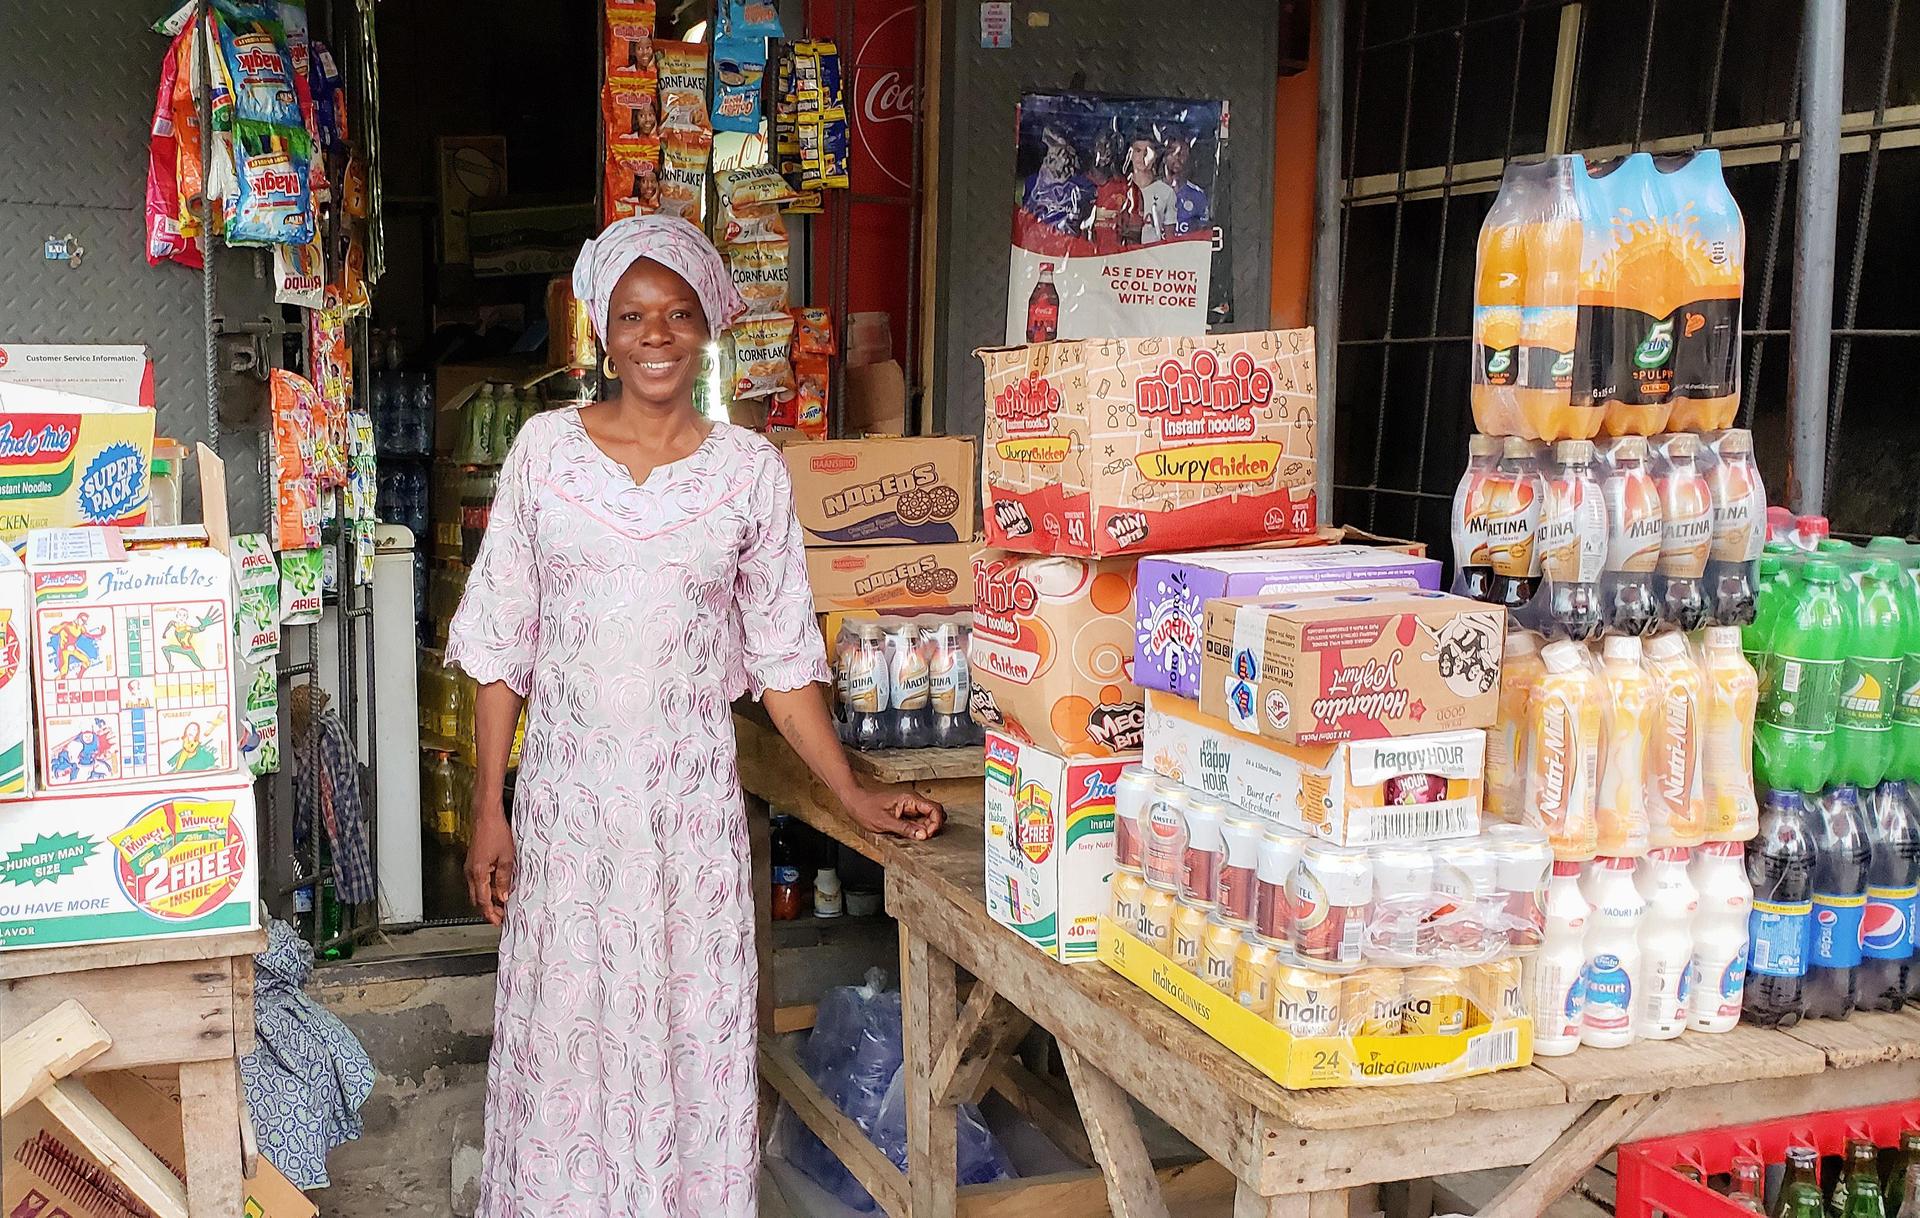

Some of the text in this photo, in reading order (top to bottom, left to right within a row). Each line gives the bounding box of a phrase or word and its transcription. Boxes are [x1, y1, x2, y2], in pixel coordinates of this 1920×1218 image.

[238, 51, 283, 73] Magik
[660, 76, 705, 90] ORNFLAKES
[659, 169, 704, 187] ORNFLAKES
[732, 268, 789, 284] CORNFLAKES
[1102, 266, 1198, 283] AS E DEY HOT,
[1153, 281, 1197, 295] DOWN
[1118, 293, 1196, 308] WITH COKE
[26, 354, 61, 362] Customer
[64, 354, 90, 362] Service
[738, 345, 788, 363] CORNFLAK
[1137, 352, 1273, 415] minimie
[1164, 416, 1252, 437] instant noodles
[84, 455, 138, 499] SUPER
[22, 481, 52, 494] Noodles
[91, 476, 133, 513] PACK
[1292, 509, 1307, 529] 40
[1713, 506, 1748, 521] TINA
[1068, 519, 1085, 542] 40
[1108, 513, 1147, 540] MINI
[1487, 519, 1528, 537] ALTINA
[1664, 519, 1710, 539] ALTINA
[242, 554, 272, 569] ARIEL
[96, 565, 213, 600] Indomitables
[290, 597, 320, 611] ARIEL
[251, 630, 278, 647] ARIEL
[1329, 650, 1403, 695] Yoghurt
[1313, 690, 1408, 725] Hollandia
[1841, 695, 1880, 712] TEEM
[1087, 708, 1144, 745] MEG
[1663, 692, 1689, 805] Nutri-Milk
[1200, 747, 1231, 774] happy
[1540, 703, 1568, 818] Nutri-Milk
[1201, 772, 1229, 793] HOUR
[1246, 785, 1274, 806] Burst of
[1240, 796, 1280, 820] Refreshment
[180, 815, 224, 829] MUNCH
[125, 826, 165, 855] MUNCH
[1028, 825, 1049, 843] FREE
[6, 845, 84, 872] HUNGRY MAN
[169, 842, 219, 865] MUNCH IT
[35, 863, 61, 878] SIZE
[144, 849, 232, 900] 2 FREE
[169, 884, 211, 908] INSIDE
[0, 898, 110, 917] OU HAVE MORE
[0, 926, 36, 937] LAVOR
[1068, 925, 1085, 937] 40
[1137, 918, 1167, 938] alta
[1114, 938, 1126, 958] 24
[1819, 926, 1833, 959] pepsi
[1177, 988, 1210, 1021] GUINNESS
[1278, 1000, 1337, 1022] Malta
[1313, 1050, 1340, 1070] 24
